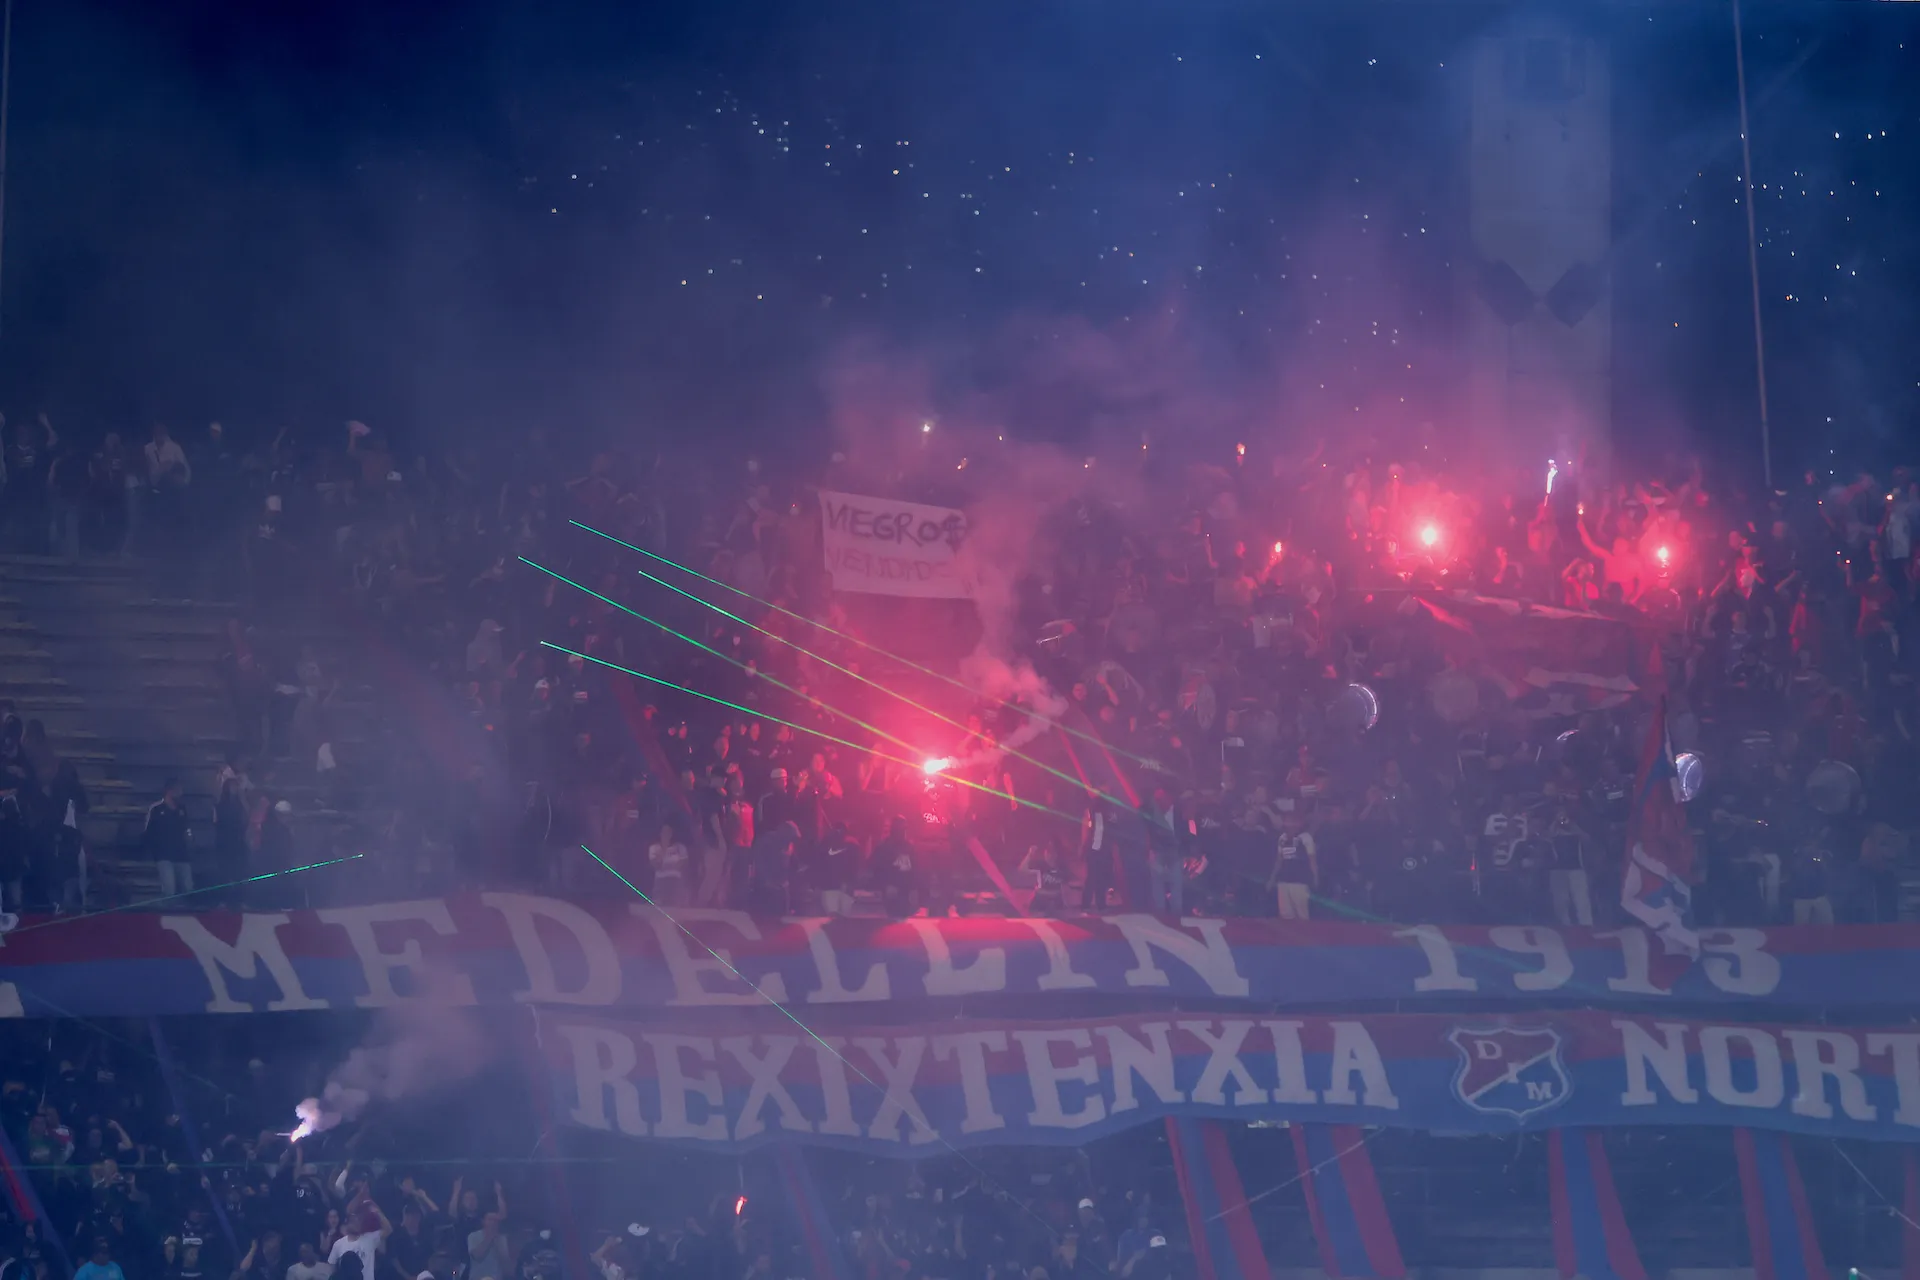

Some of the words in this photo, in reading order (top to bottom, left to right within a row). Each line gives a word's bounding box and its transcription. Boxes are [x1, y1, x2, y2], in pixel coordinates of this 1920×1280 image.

[160, 892, 1249, 1013] MEDELLIN
[1392, 924, 1781, 996] 1913
[556, 1019, 1399, 1145] REXIXTENXIA
